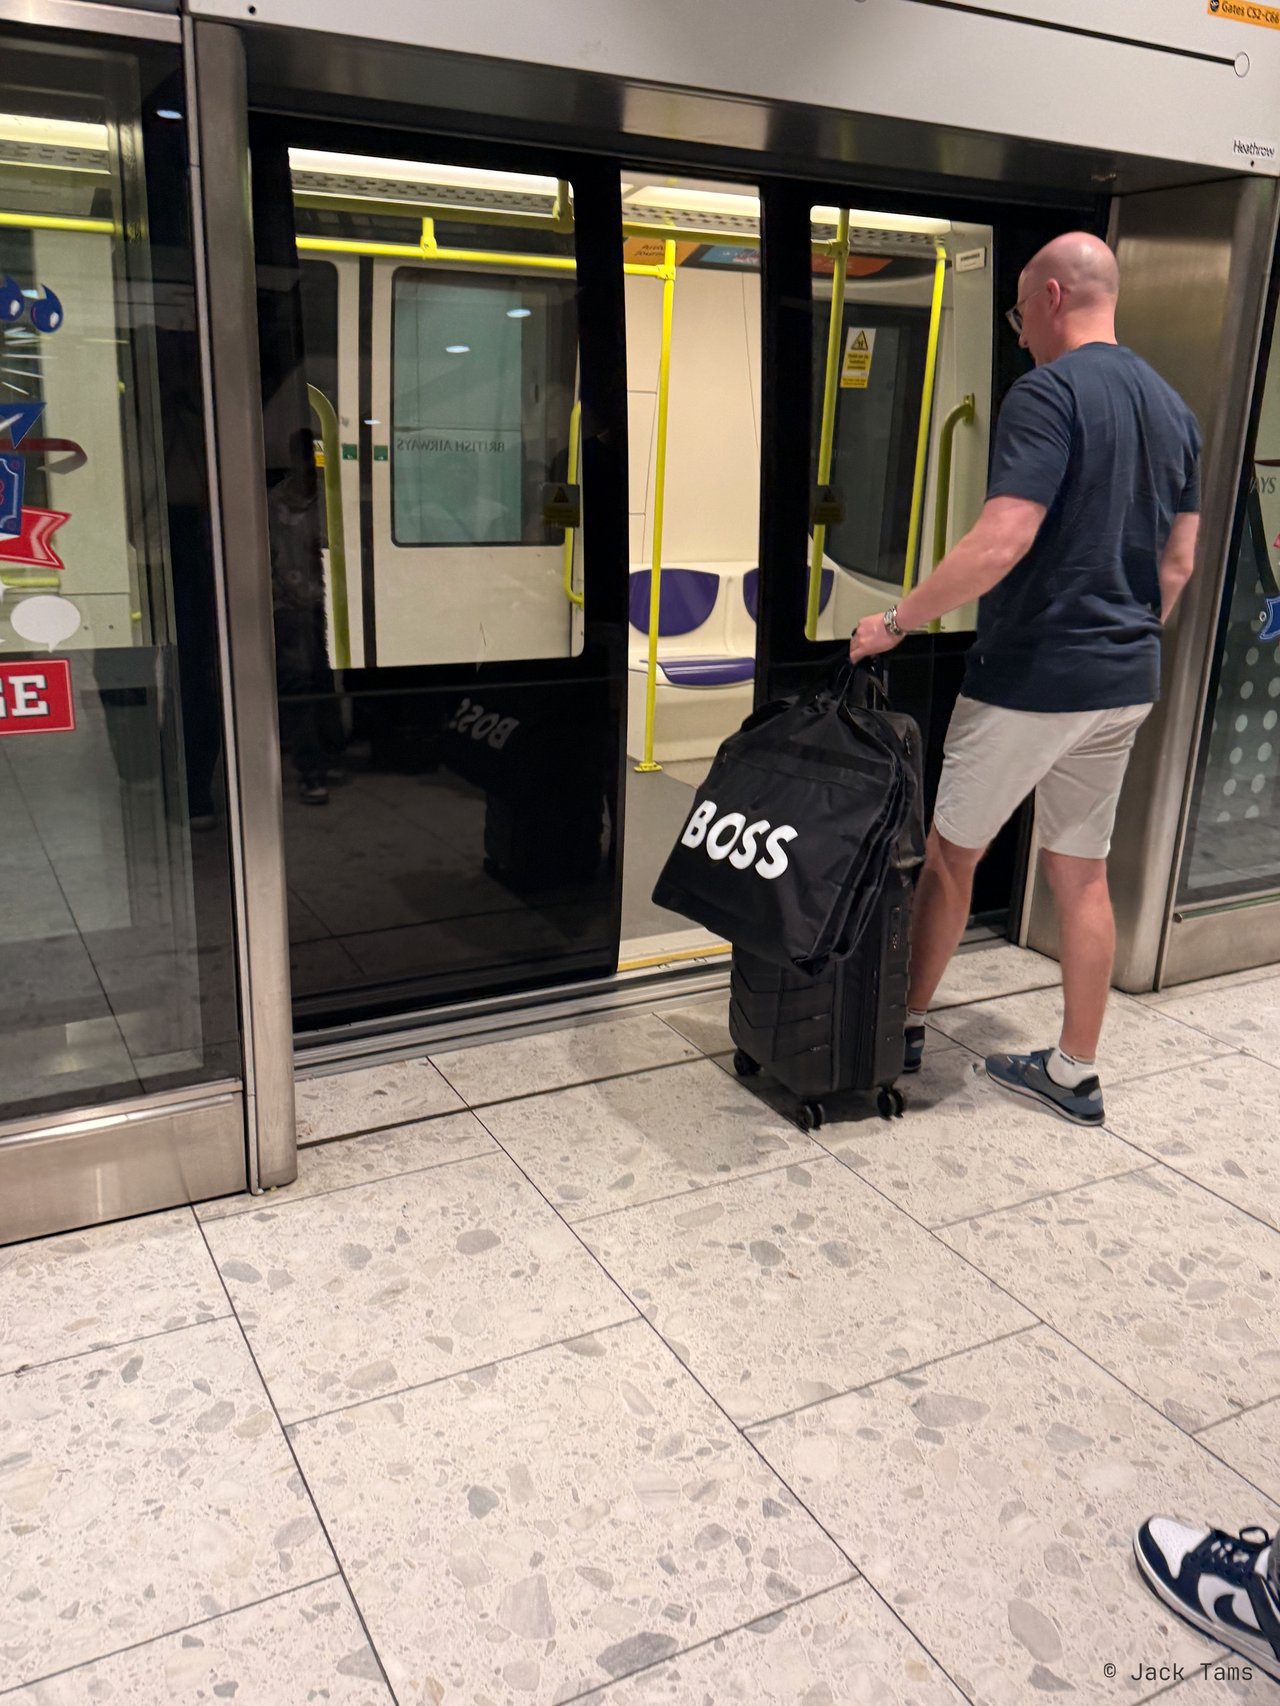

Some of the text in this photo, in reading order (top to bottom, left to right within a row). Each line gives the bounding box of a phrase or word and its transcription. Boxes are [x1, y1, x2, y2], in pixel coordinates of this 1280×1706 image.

[1221, 1, 1245, 17] Gates
[1233, 139, 1275, 158] Heathrow
[1249, 476, 1277, 495] AYS
[681, 800, 799, 880] BOSS
